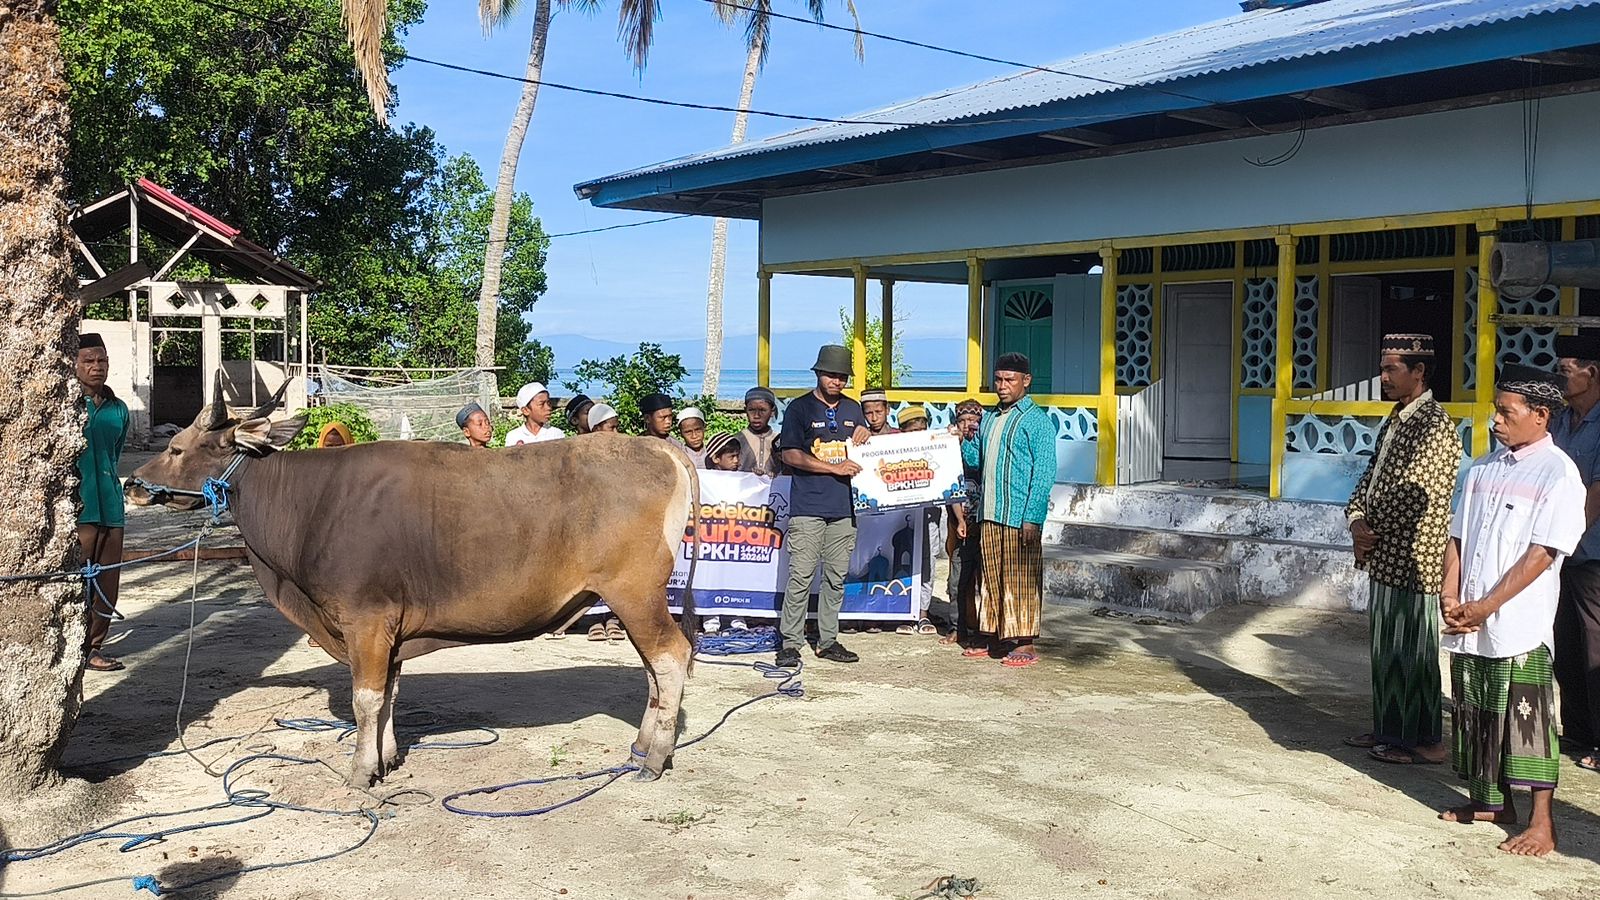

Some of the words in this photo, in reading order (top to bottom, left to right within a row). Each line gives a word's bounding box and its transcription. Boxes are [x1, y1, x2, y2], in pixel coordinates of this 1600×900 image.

[861, 449, 895, 458] PROGRAM
[895, 443, 947, 455] KEMASLAHATAN
[885, 459, 928, 471] Sedekah
[883, 469, 934, 483] Qurban
[888, 480, 915, 490] BPKH
[741, 553, 769, 561] 2026M
